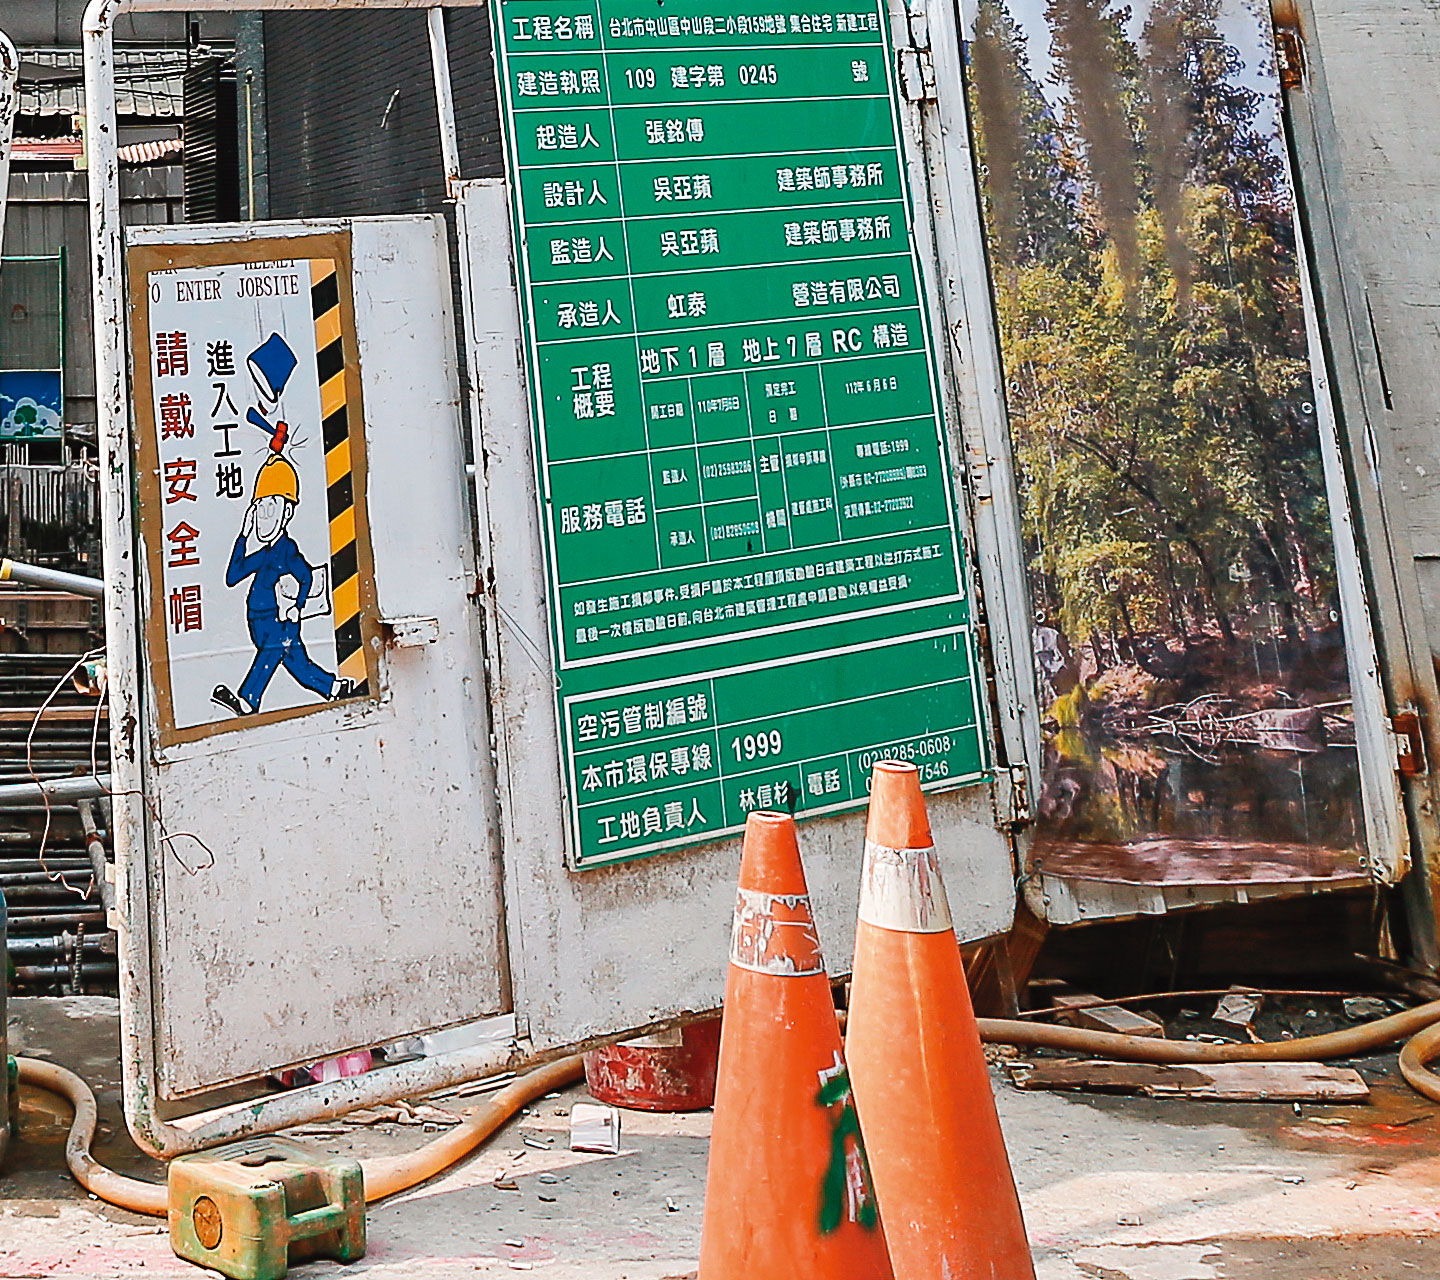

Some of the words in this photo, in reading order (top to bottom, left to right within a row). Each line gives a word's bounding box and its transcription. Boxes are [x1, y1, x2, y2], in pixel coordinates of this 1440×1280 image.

[511, 14, 595, 42] 工程名稱
[609, 14, 788, 39] 台北市中山區中山段二小段159地號
[790, 13, 833, 36] 集合住宅
[836, 11, 879, 33] 新建工程
[517, 68, 602, 97] 建造執照
[625, 67, 656, 90] 109
[670, 64, 725, 89] 建字第
[738, 64, 778, 86] 0245
[852, 59, 869, 84] 號
[536, 123, 601, 150] 起造人
[645, 118, 704, 144] 張銘傳
[543, 180, 607, 208] 設計人
[654, 174, 713, 201] 吳亞蘋
[776, 162, 884, 193] 建築師事務所
[550, 236, 615, 266] 監造人
[660, 229, 720, 257] 吳亞蘋
[783, 215, 892, 248] 建築師事務所
[176, 279, 221, 302] ENTER
[237, 274, 299, 298] JOBSITE
[667, 292, 708, 318] 虹泰
[792, 273, 901, 309] 營造有限公司
[557, 300, 622, 328] 承造人
[833, 327, 862, 353] RC
[872, 323, 909, 350] 構造
[570, 364, 613, 390] 工程
[206, 340, 244, 501] 進入工地
[572, 391, 617, 420] 概要
[155, 330, 204, 635] 請戴安全帽
[662, 468, 688, 485] 監造人
[560, 495, 647, 535] 服務電話
[670, 529, 696, 547] 承造人
[578, 692, 709, 743] 空污管制編號
[731, 729, 783, 762] 1999
[581, 743, 714, 792] 本市環保專線
[738, 779, 791, 813] 林信杉
[807, 771, 841, 797] 電話
[597, 796, 708, 844] 工地負責人
